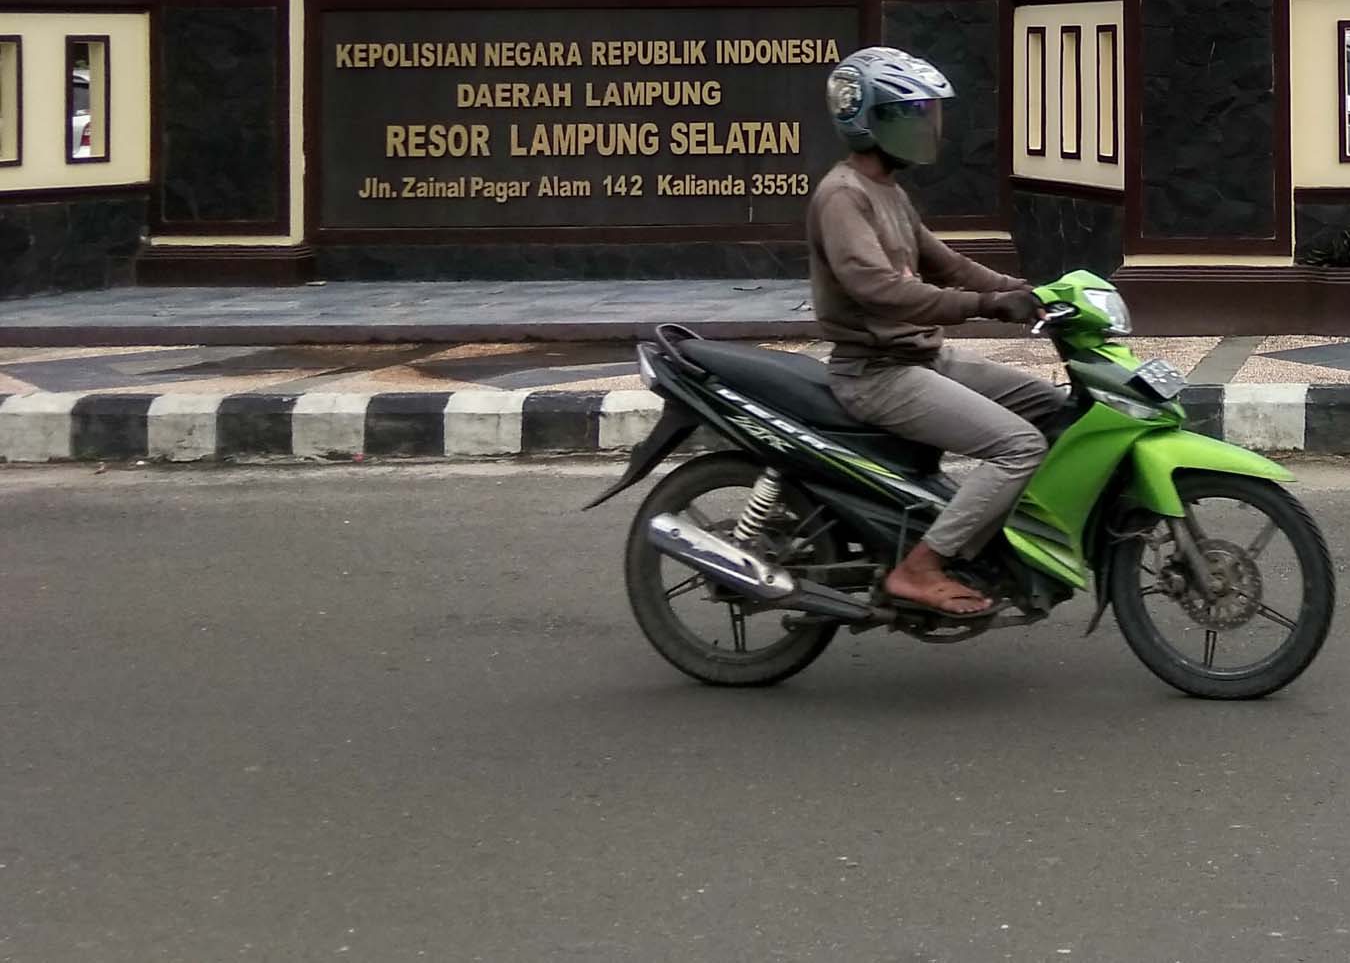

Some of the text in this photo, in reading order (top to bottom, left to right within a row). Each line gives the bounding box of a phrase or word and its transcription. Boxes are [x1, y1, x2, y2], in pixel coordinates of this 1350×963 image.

[336, 39, 840, 68] KEPOLISIAN NEGARA REPUBLIK INDONESIA
[457, 81, 721, 108] DAERAH LAMPUNG
[386, 122, 800, 157] RESOR LAMPUNG SELATAN
[359, 174, 809, 203] Jln. Zainal Pagar Alam 142 Kalianda 35513
